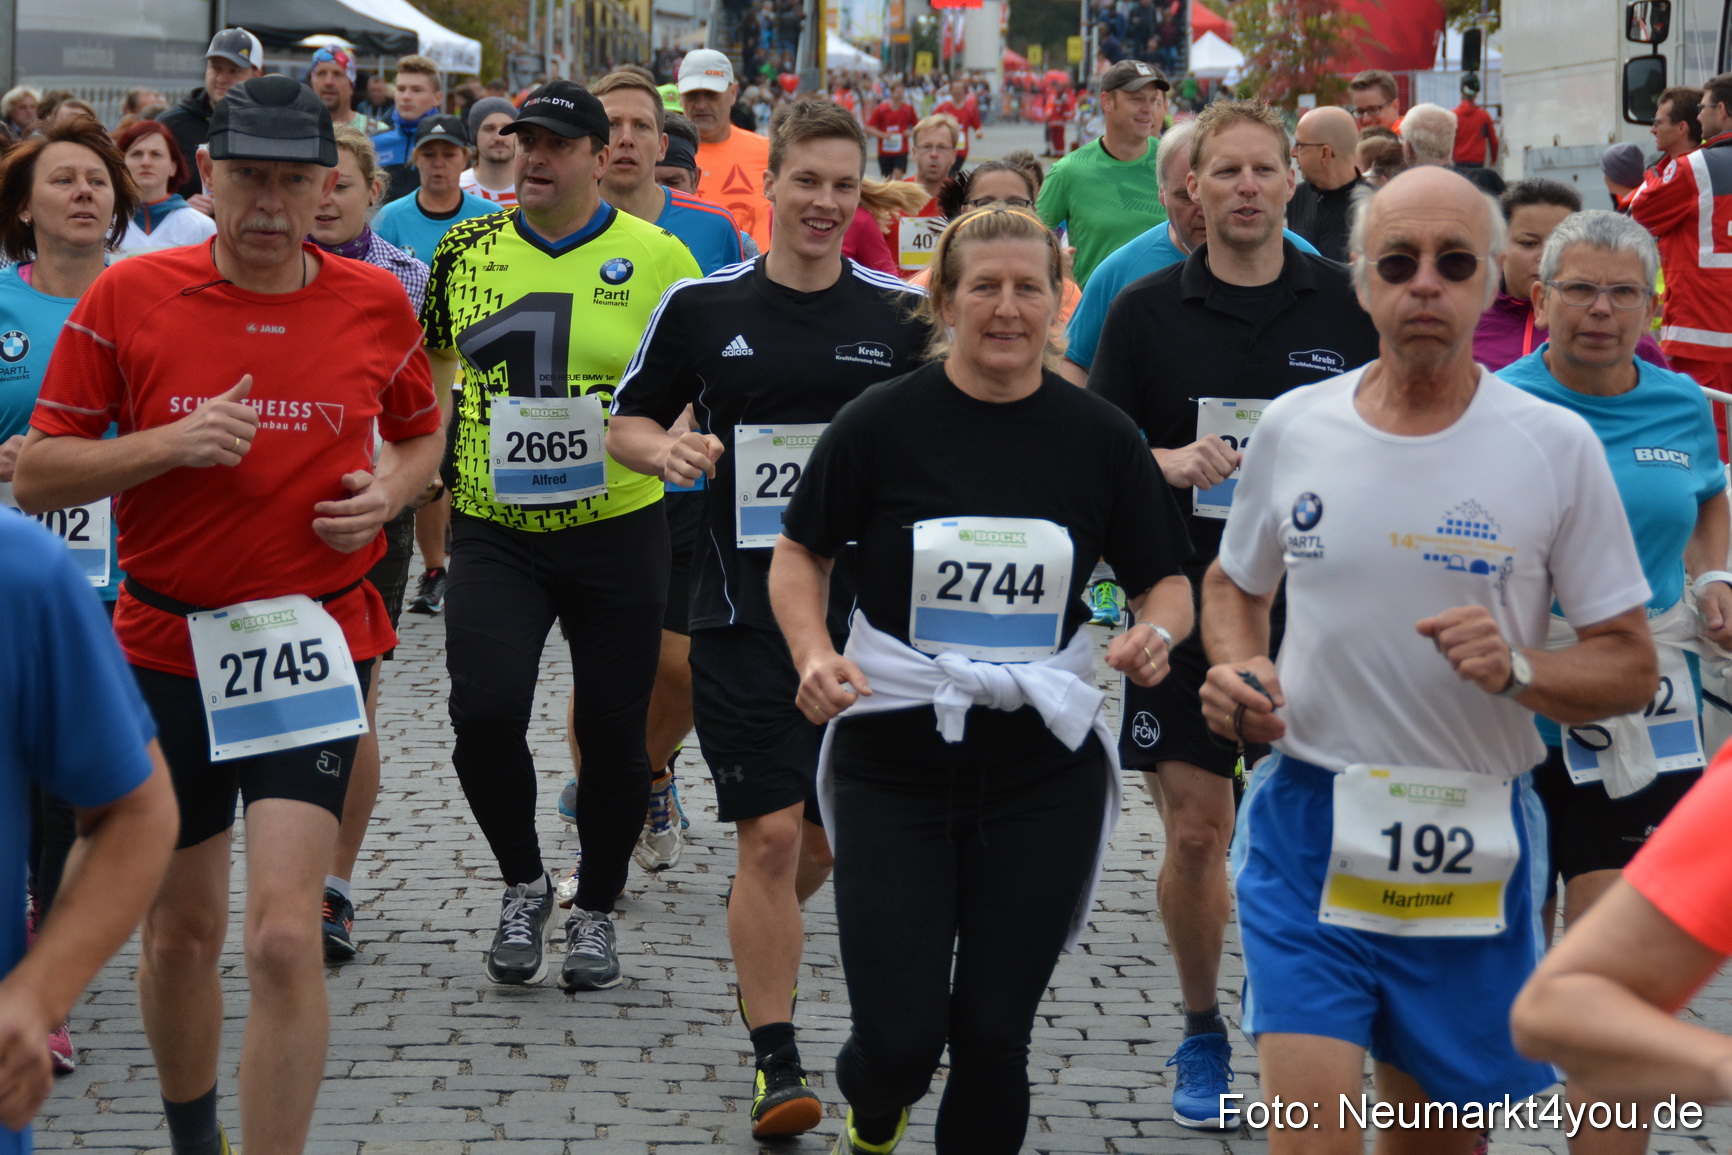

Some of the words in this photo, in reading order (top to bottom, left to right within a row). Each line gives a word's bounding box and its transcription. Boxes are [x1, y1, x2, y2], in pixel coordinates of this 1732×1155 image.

[552, 97, 574, 109] DTM
[594, 287, 630, 301] Partl
[592, 299, 628, 307] Neumarkt
[260, 325, 286, 334] JAKO
[722, 348, 754, 357] adidas
[858, 346, 884, 357] Krebs
[1312, 353, 1336, 365] Krebs
[530, 408, 569, 418] BOCK
[294, 421, 308, 431] AG
[506, 429, 588, 463] 2665
[786, 435, 820, 446] BOC
[1633, 446, 1691, 471] BOCK
[532, 473, 567, 486] Alfred
[974, 530, 1027, 544] BOCK
[936, 560, 1045, 605] 2744
[243, 609, 297, 629] BOCK
[219, 637, 330, 698] 2745
[1134, 725, 1157, 740] FCN
[1408, 784, 1467, 802] BOCK
[1381, 821, 1475, 875] 192
[1381, 889, 1455, 908] Hartmut
